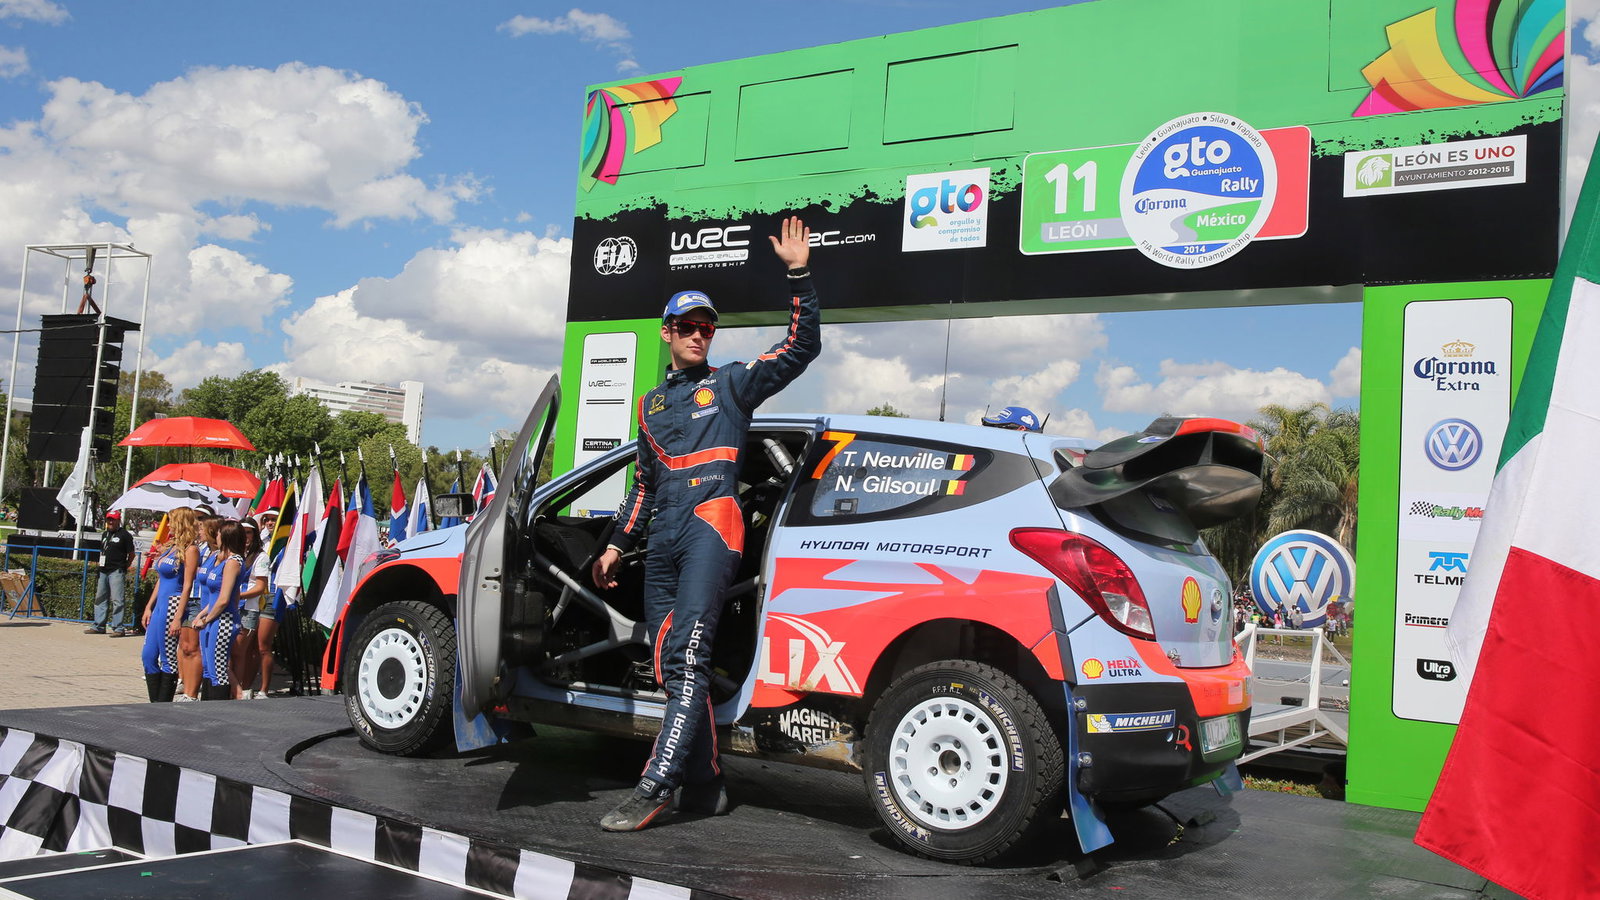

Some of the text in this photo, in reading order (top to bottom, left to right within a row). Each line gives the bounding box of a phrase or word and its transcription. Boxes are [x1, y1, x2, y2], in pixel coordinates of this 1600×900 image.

[1136, 114, 1262, 160] León Guanajuato Silao Irapuato
[1163, 136, 1231, 179] gto
[1395, 145, 1515, 168] LEÓN ES UNO
[1191, 166, 1242, 176] Guanajuato
[1398, 165, 1511, 182] AYUNTAMIENTO 2012-2015
[1044, 160, 1097, 214] 11
[1221, 177, 1259, 193] Rally
[909, 178, 983, 229] gto
[1134, 198, 1187, 215] Corona
[949, 218, 975, 227] orgullo
[1196, 213, 1247, 228] México
[671, 225, 751, 251] WRC
[938, 226, 981, 235] compromiso
[959, 235, 980, 243] todos
[1048, 221, 1098, 240] LEÓN
[685, 254, 715, 262] WORLD
[716, 252, 747, 260] RALLY
[1140, 232, 1251, 266] FIA World Rally Championship
[1183, 245, 1206, 254] 2014
[670, 261, 746, 271] CHAMPIONSHIP
[1413, 357, 1496, 381] Corona
[1436, 377, 1480, 391] Extra
[812, 431, 856, 479] 7
[843, 451, 945, 470] T. Neuville
[834, 475, 937, 496] N. Gilsoul
[800, 540, 992, 558] HYUNDAI MOTORSPORT
[1107, 656, 1142, 669] HELIX
[1424, 661, 1450, 674] Ultra
[1109, 668, 1142, 677] ULTRA
[1115, 713, 1173, 727] MICHELIN
[656, 712, 687, 777] HYUNDAI
[990, 703, 1024, 771] MICHELIN
[874, 773, 916, 834] MICHELIN
